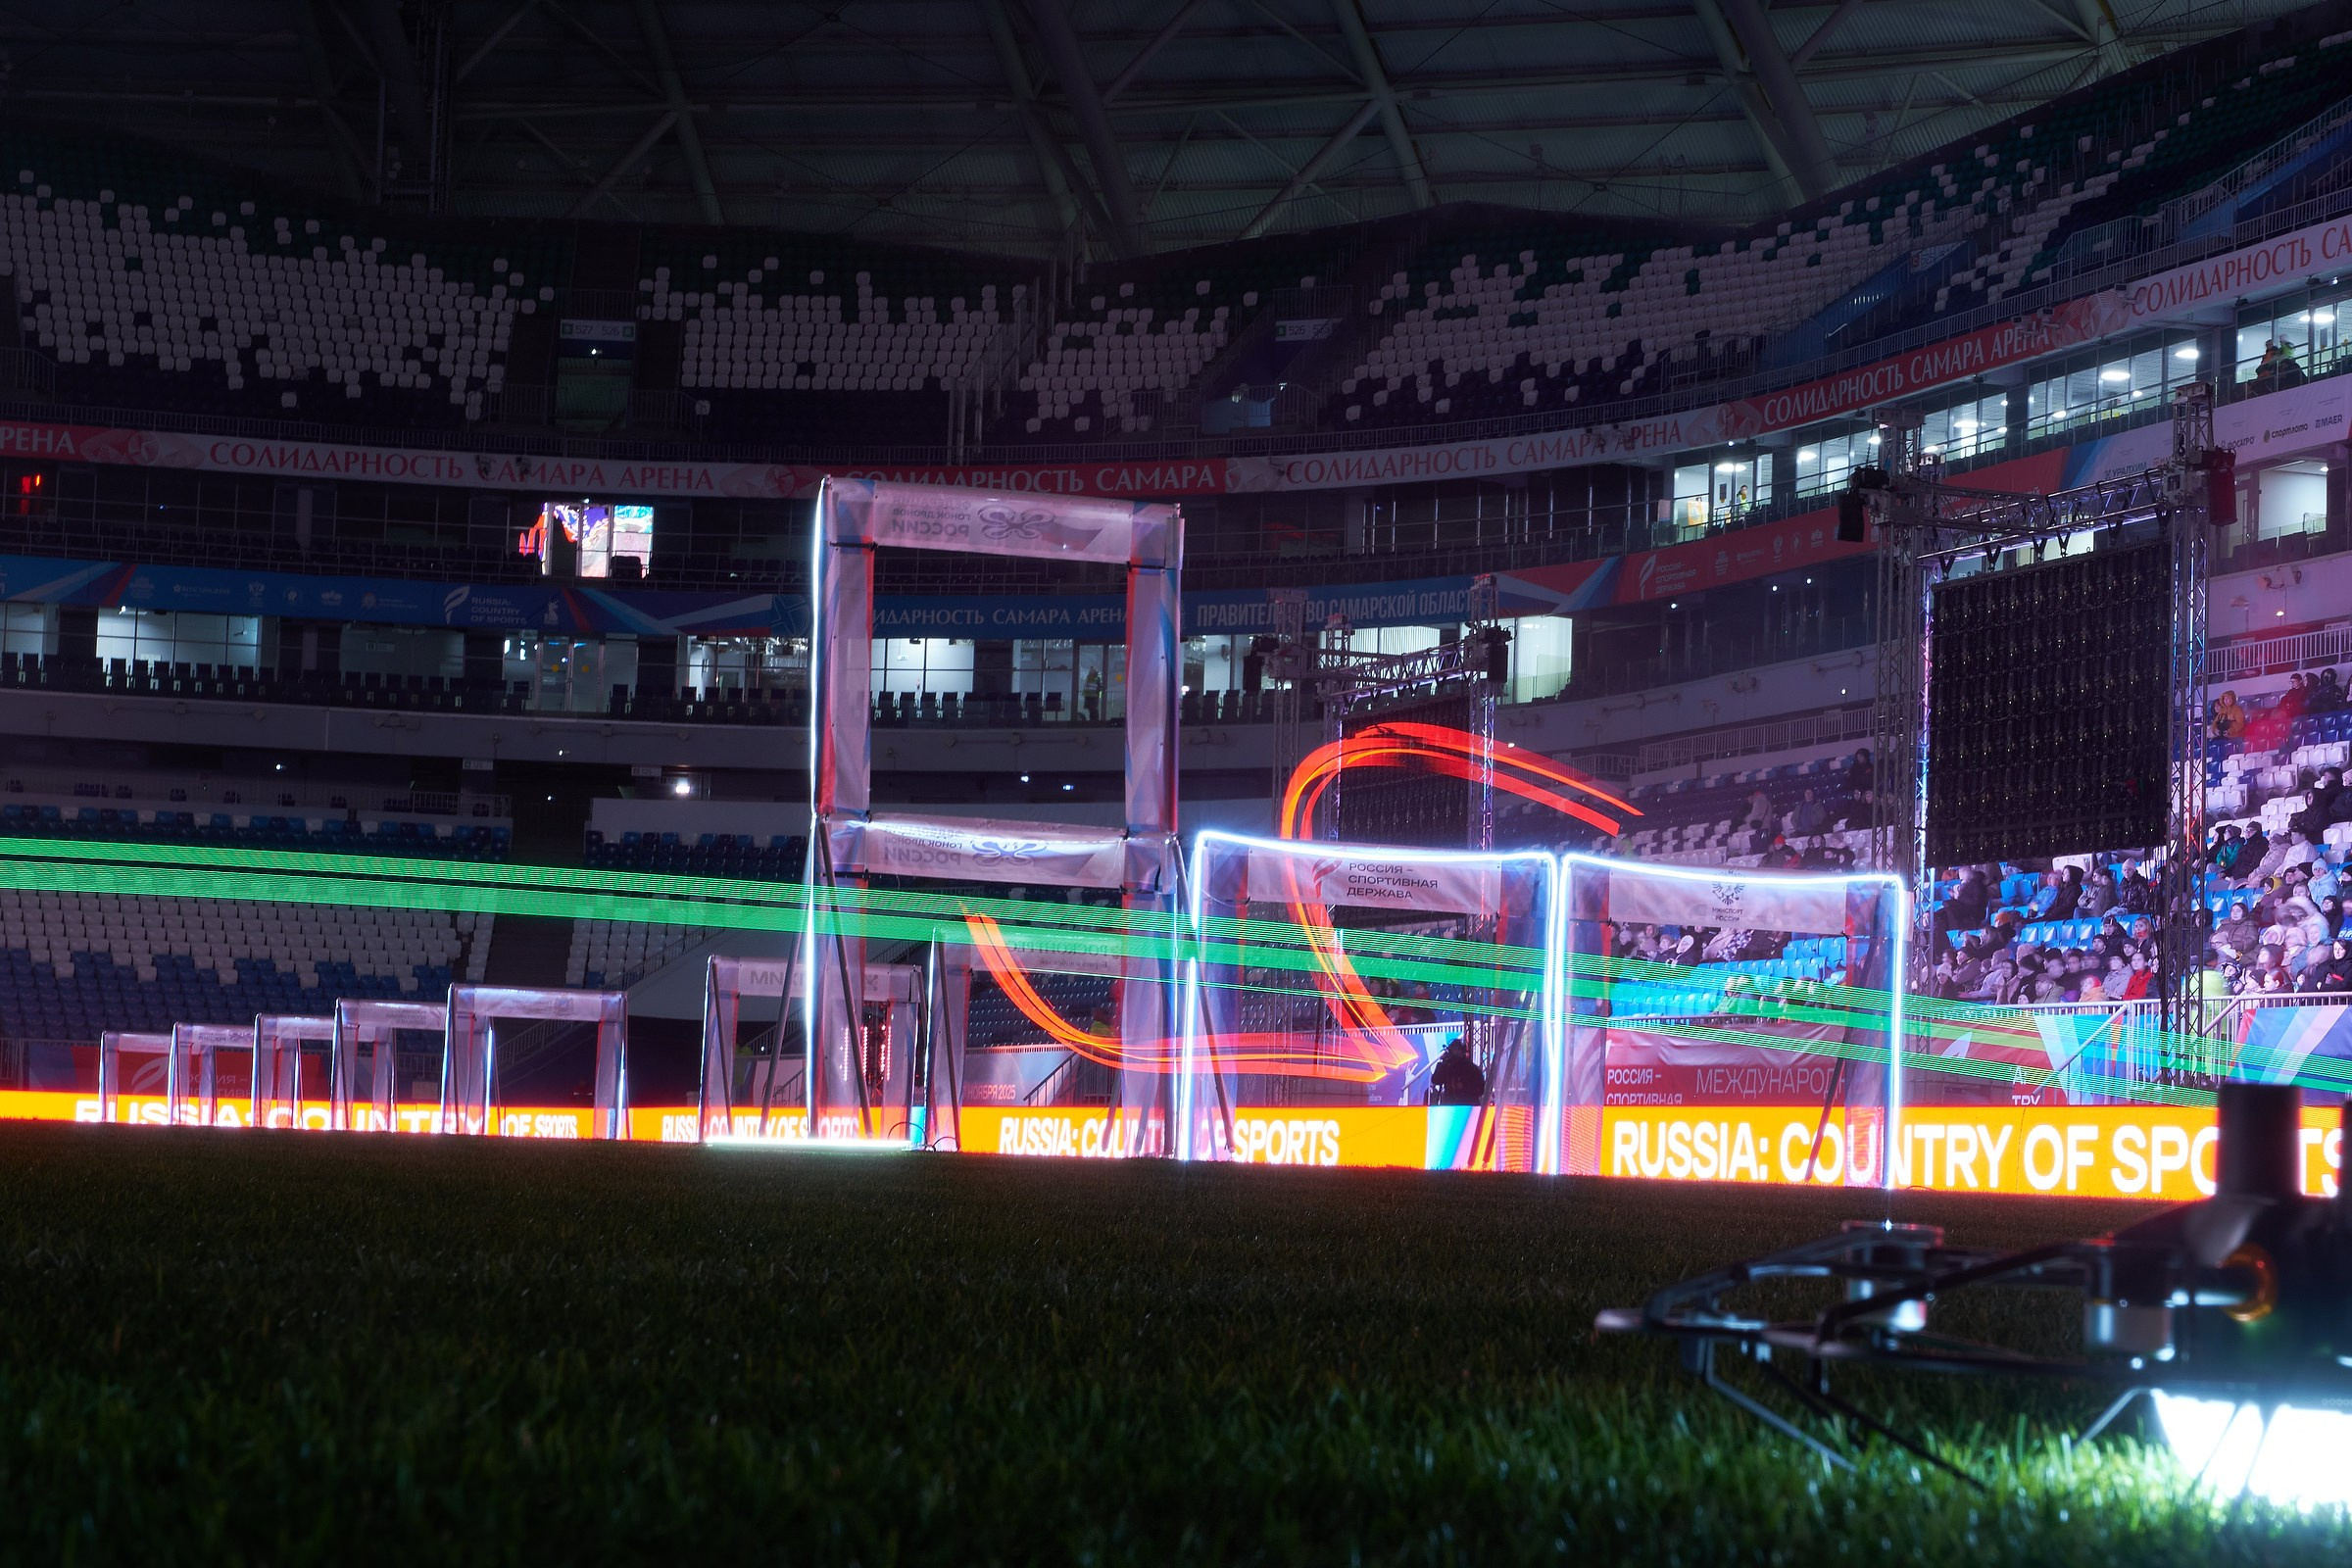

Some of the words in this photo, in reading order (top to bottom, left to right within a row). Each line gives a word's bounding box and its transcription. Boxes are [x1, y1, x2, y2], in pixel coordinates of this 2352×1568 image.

[2132, 237, 2313, 317] СОЛИДАРНОСТЬ
[1763, 363, 1904, 425] СОЛИДАРНОСТЬ
[1909, 343, 1984, 385] САМАРА
[2321, 414, 2343, 428] MAER
[210, 443, 464, 481] СОЛИДАРНОСТЬ
[476, 460, 607, 488] САМАРА
[617, 466, 715, 492] АРЕНА
[1285, 445, 1496, 485] СОЛИДАРНОСТЬ
[1506, 432, 1606, 467] САМАРА
[1096, 466, 1216, 492] САМАРА
[2112, 462, 2148, 481] УРАЛХИМ
[470, 607, 520, 616] COUNTRY
[487, 616, 528, 626] SPORTS
[992, 609, 1071, 625] САМАРА
[1348, 863, 1403, 875] РОССИЯ
[1348, 875, 1439, 891] СПОРТИВНАЯ
[1346, 887, 1413, 901] ДЕРЖАВА
[1607, 1069, 1653, 1086] РОССИЯ
[998, 1085, 1016, 1101] 2025
[501, 1113, 532, 1137] OF
[534, 1113, 578, 1140] SPORTS
[800, 1116, 859, 1140] SORTS
[999, 1117, 1079, 1156] RUSSIA:
[1233, 1119, 1341, 1166] SPORTS
[1613, 1121, 1769, 1180] RUSSIA:
[1780, 1122, 2014, 1189] COUNTRY
[2024, 1124, 2099, 1194] OF
[2111, 1125, 2342, 1198] SPOTS
